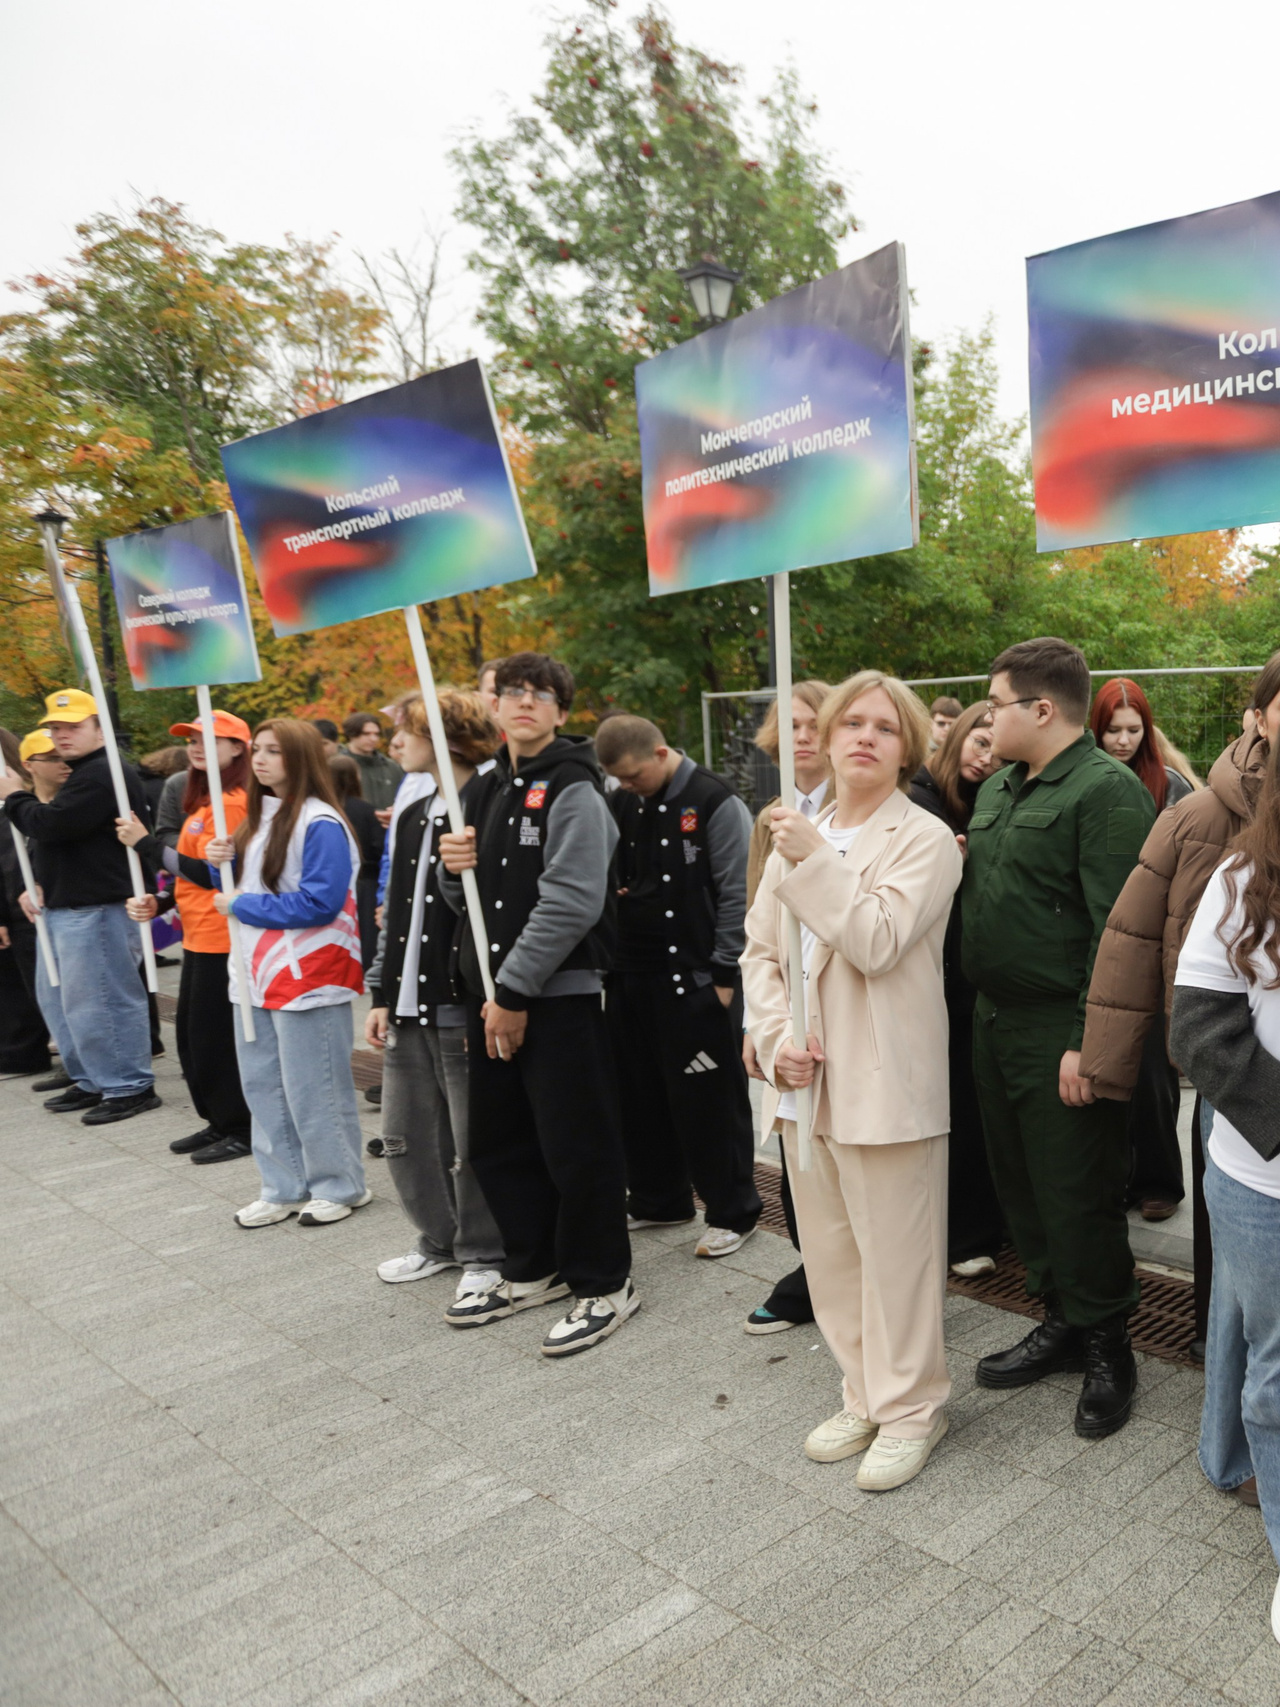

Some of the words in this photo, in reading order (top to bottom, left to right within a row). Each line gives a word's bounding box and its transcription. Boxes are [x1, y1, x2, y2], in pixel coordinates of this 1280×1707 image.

[664, 437, 790, 498] политехнический
[792, 416, 873, 459] колледж
[700, 394, 813, 456] Мончегорский
[282, 505, 392, 555] транспортный
[391, 487, 467, 522] колледж
[324, 474, 401, 514] Кольский
